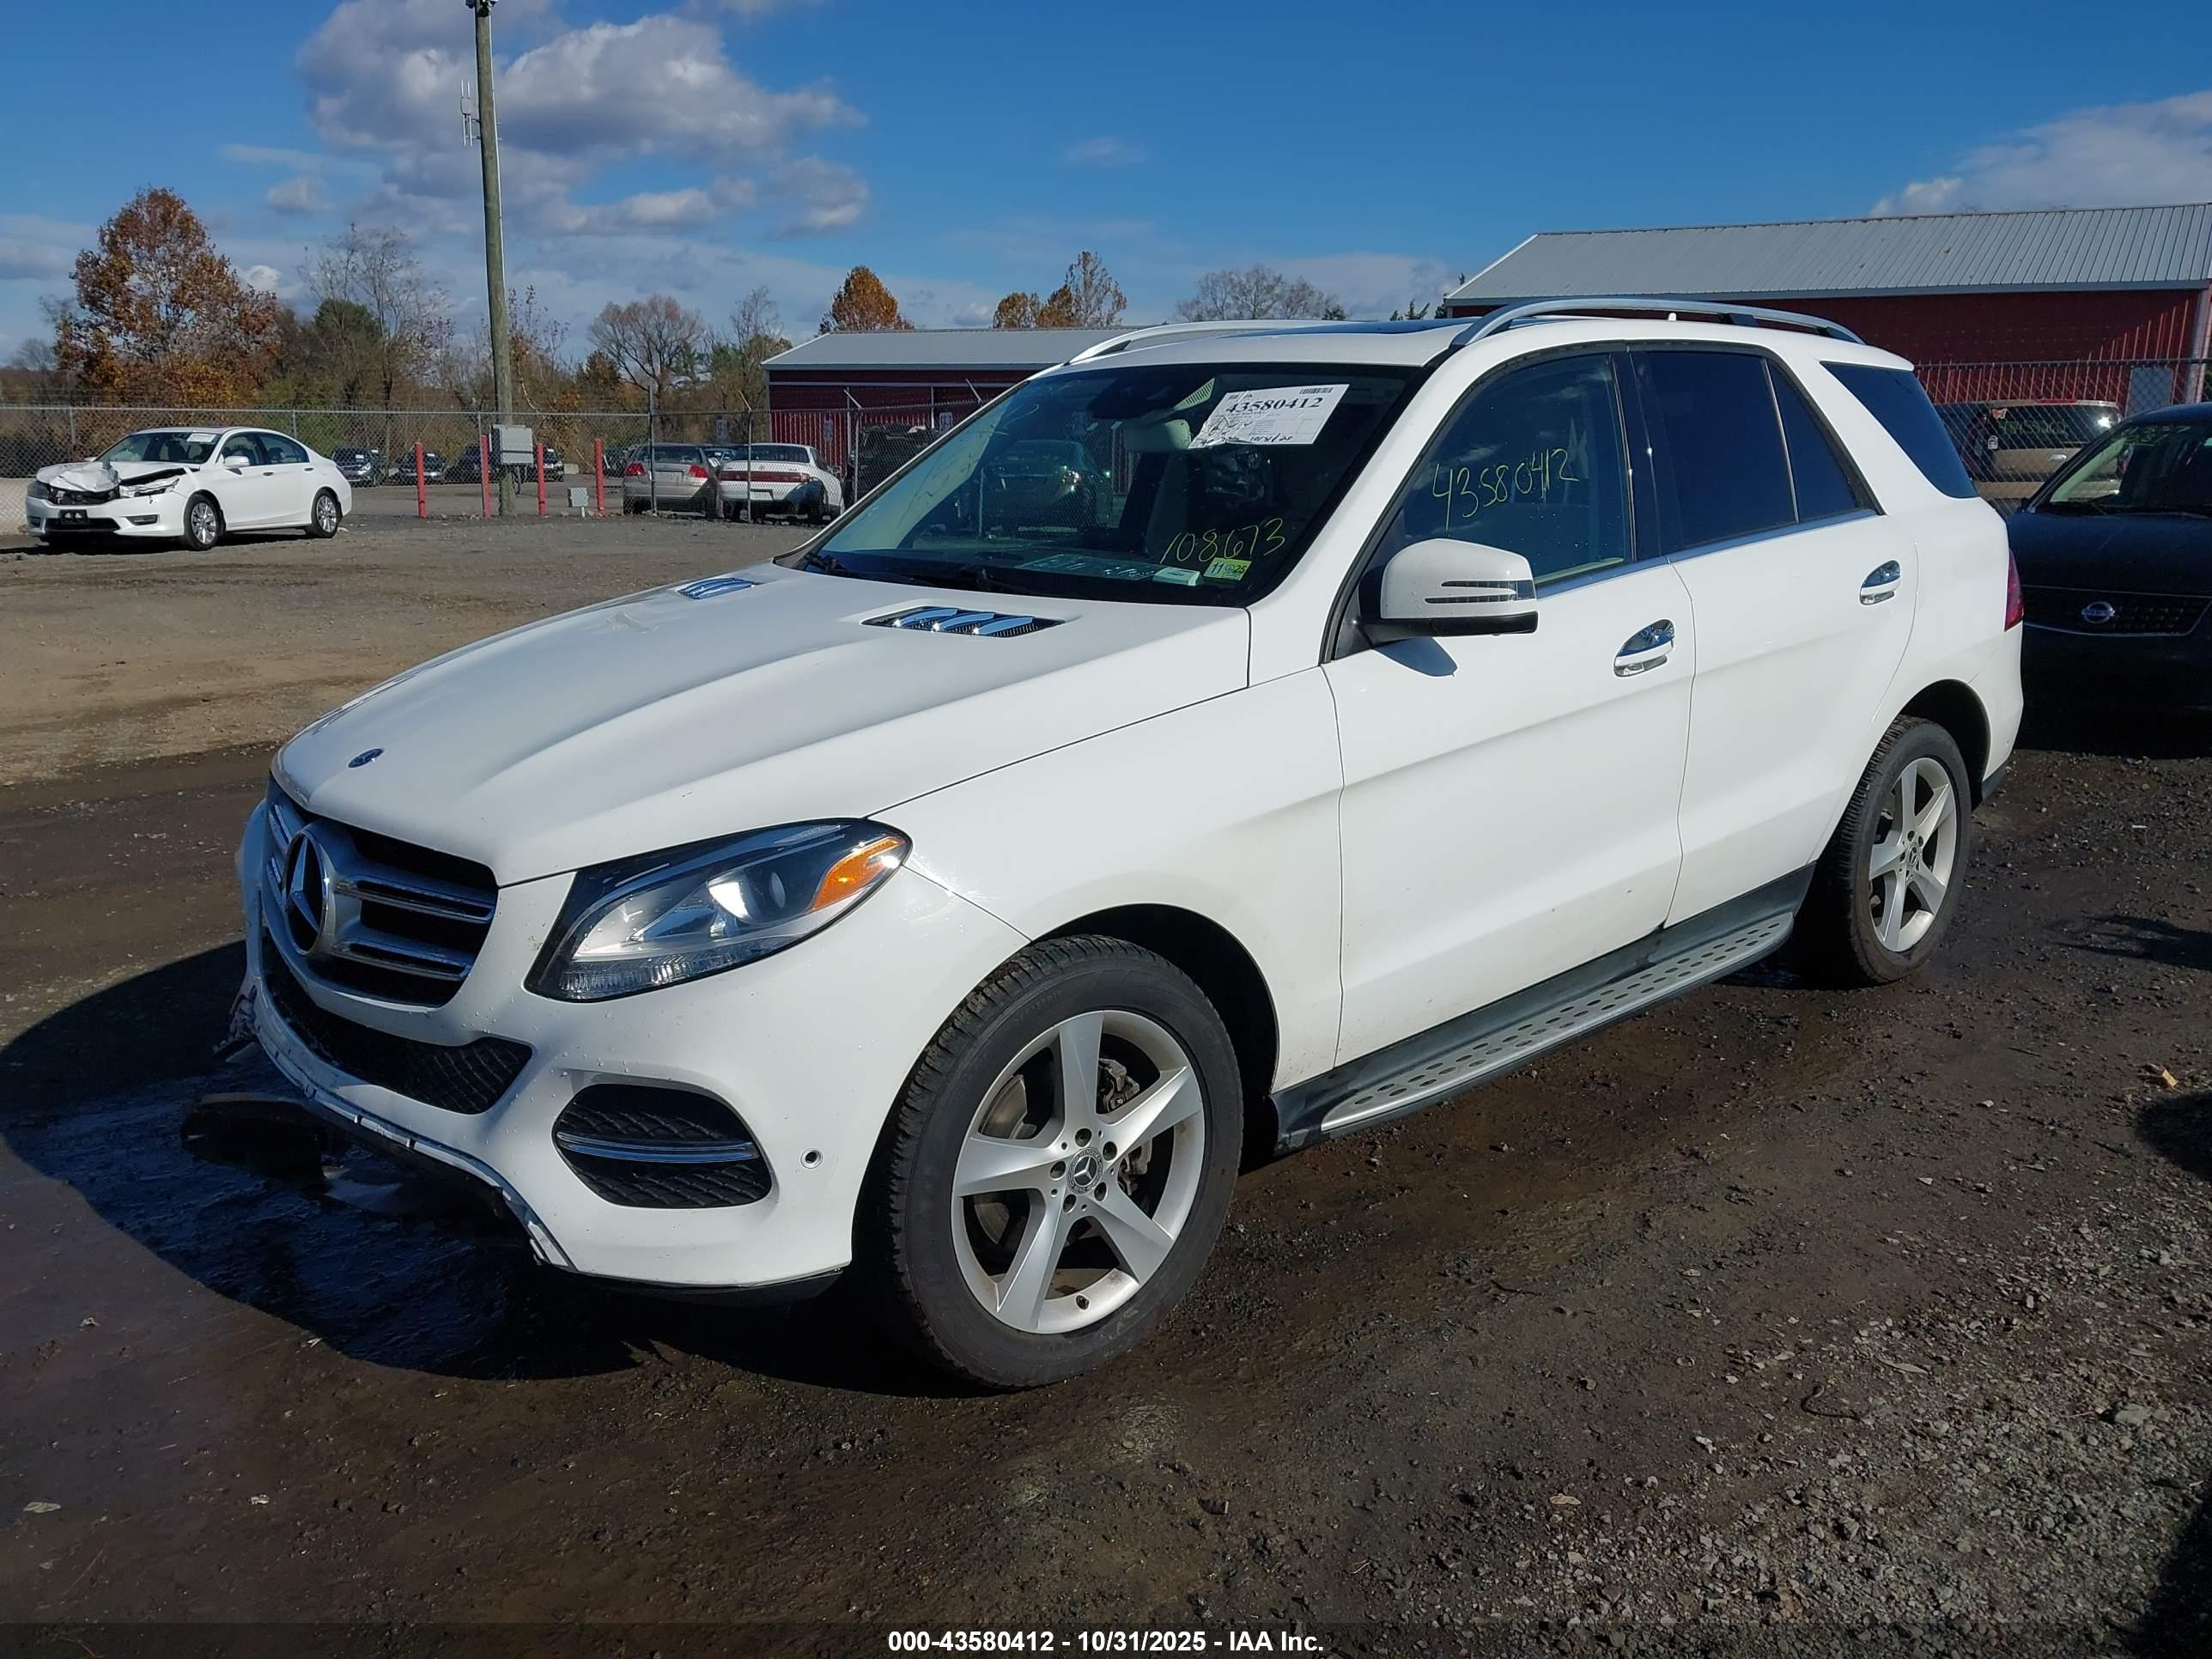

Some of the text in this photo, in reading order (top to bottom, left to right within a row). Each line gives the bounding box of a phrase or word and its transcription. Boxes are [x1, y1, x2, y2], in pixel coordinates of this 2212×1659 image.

[1225, 397, 1324, 413] 43580412
[1431, 448, 1580, 532] 43580412
[1159, 518, 1285, 565] 108673
[1211, 562, 1248, 574] 11 25
